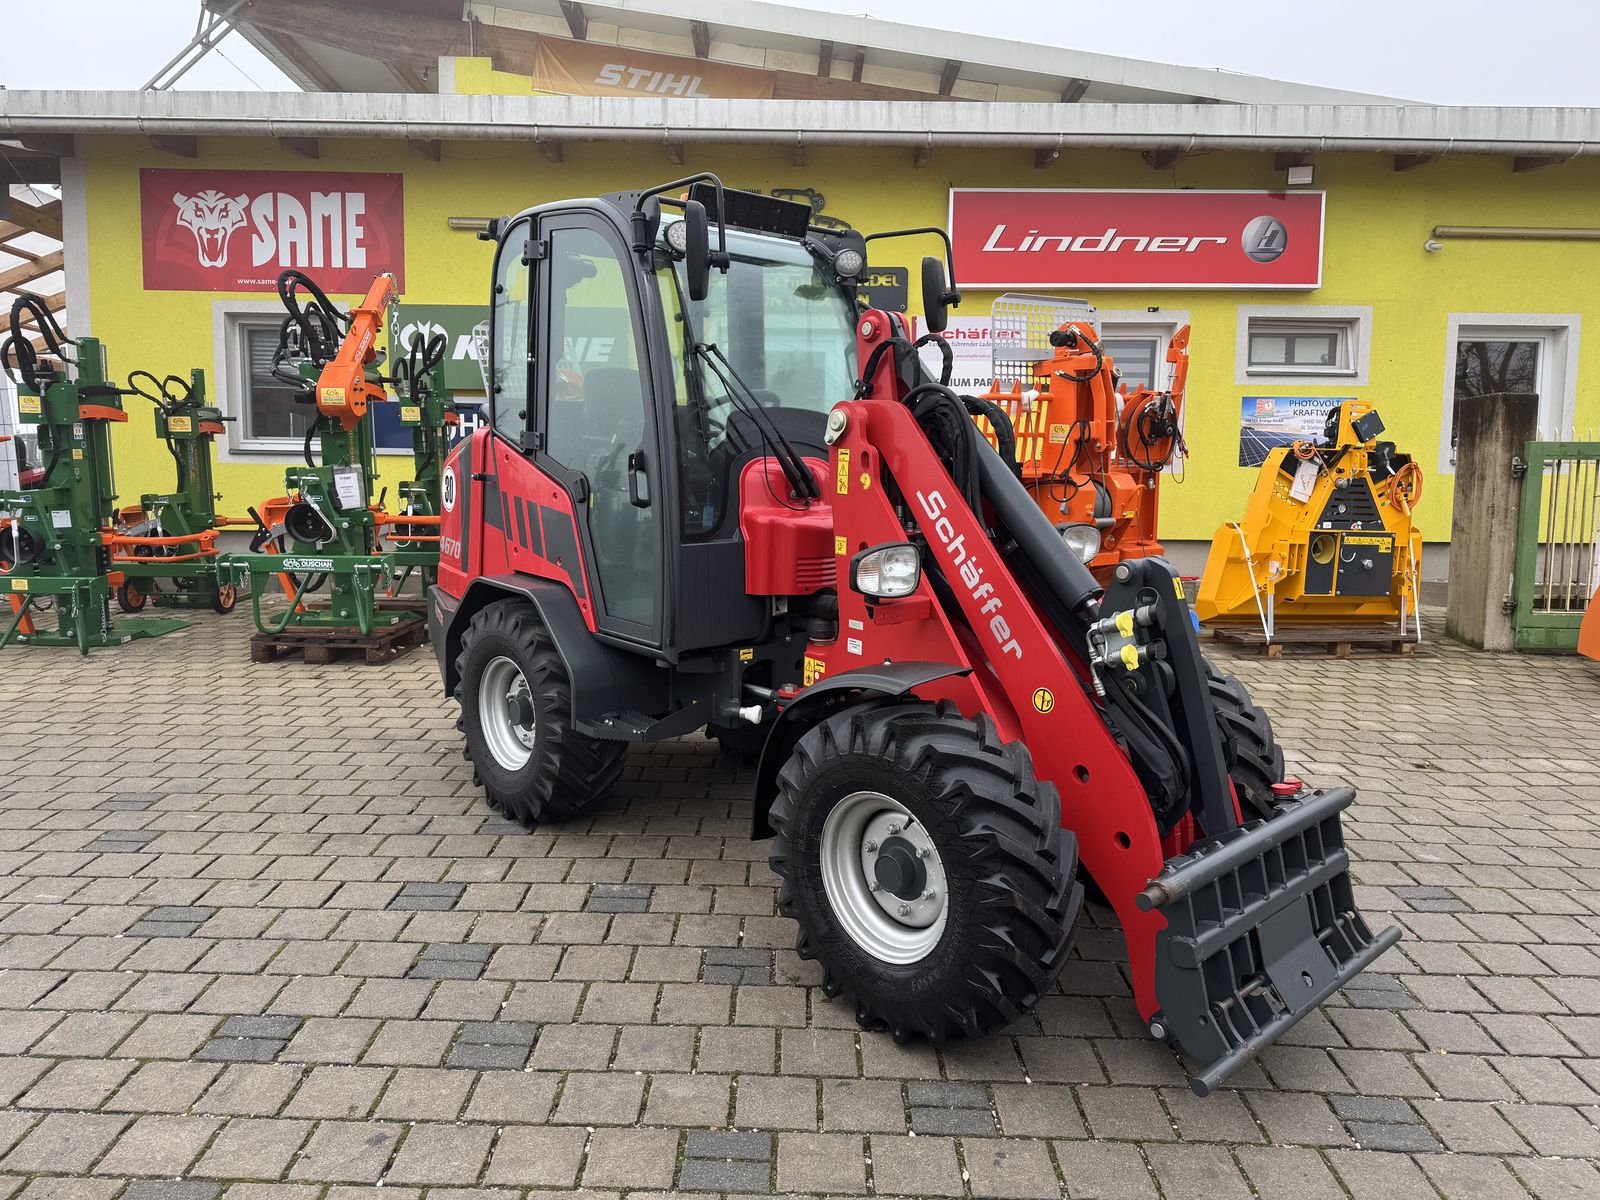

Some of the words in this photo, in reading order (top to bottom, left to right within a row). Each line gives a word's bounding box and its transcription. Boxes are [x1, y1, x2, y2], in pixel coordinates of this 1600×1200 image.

[594, 63, 710, 98] STIHL
[251, 192, 367, 269] SAME
[981, 224, 1228, 252] Lindner
[445, 474, 454, 504] 30
[440, 535, 461, 560] 4670
[915, 490, 1023, 660] Schäffer
